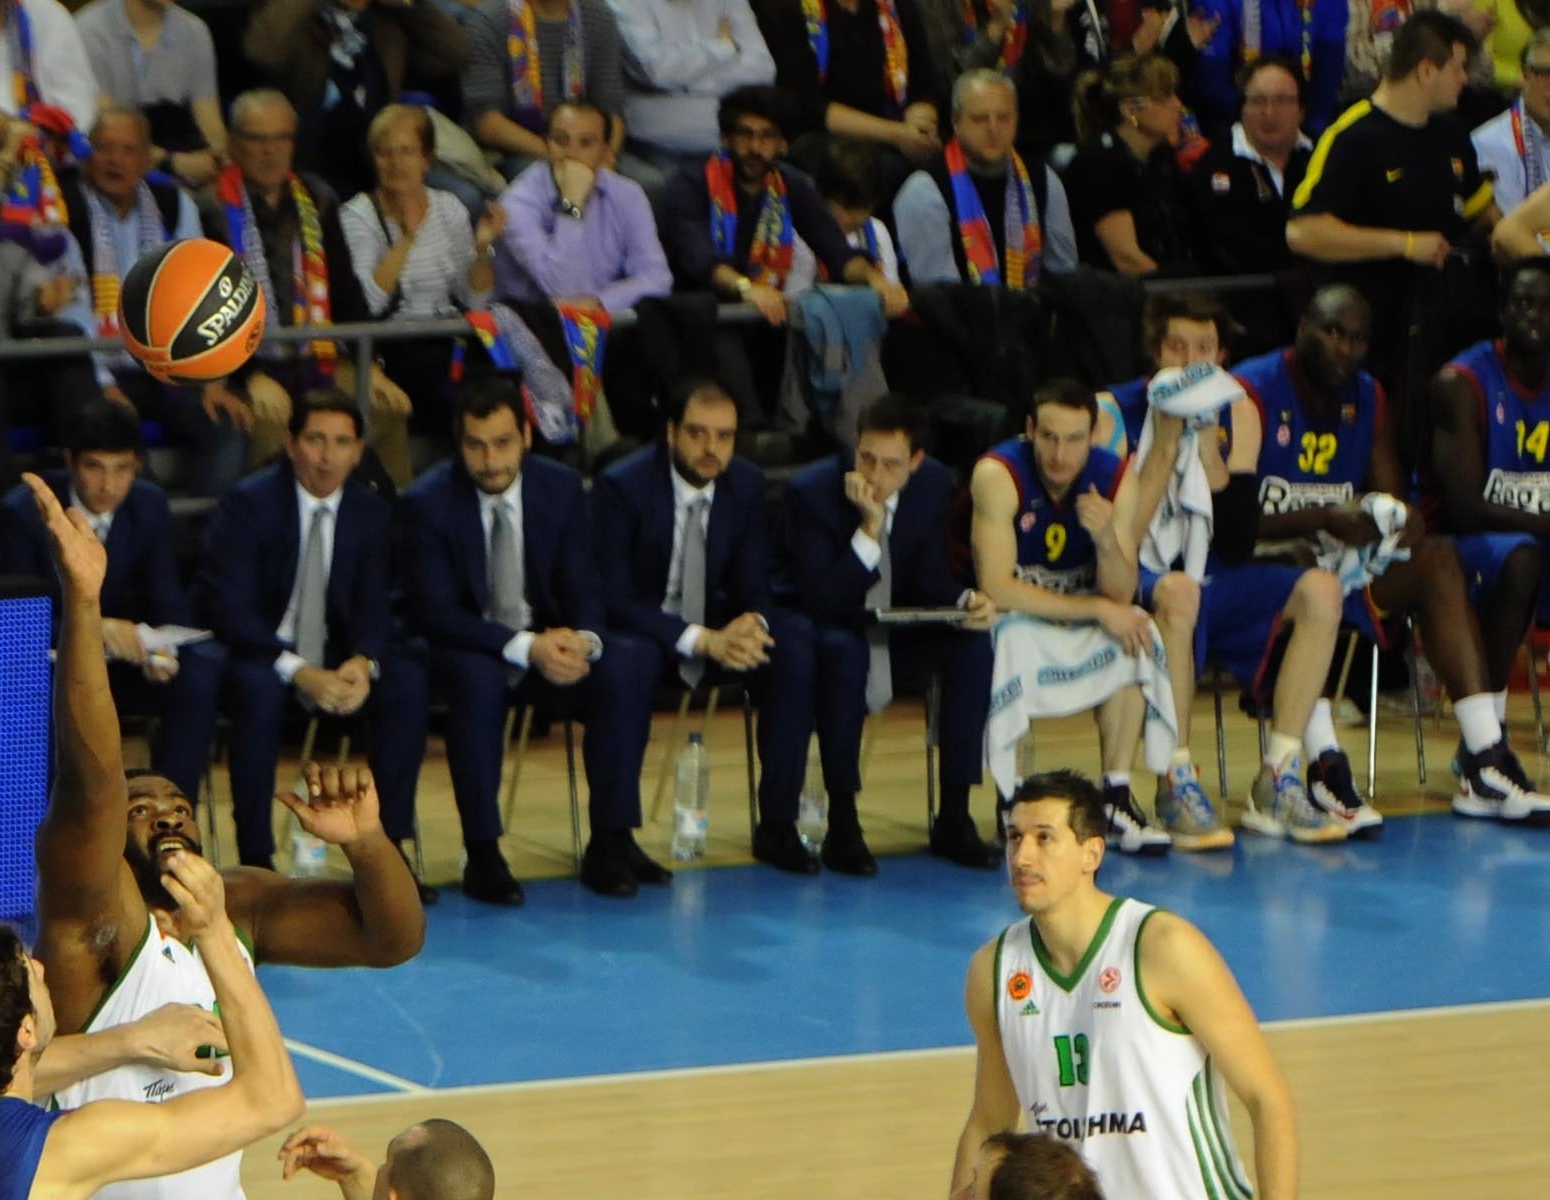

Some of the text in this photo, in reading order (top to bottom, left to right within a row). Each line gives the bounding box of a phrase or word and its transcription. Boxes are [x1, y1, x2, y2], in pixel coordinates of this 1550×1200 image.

[1298, 431, 1338, 475] 32
[1515, 419, 1550, 464] 14
[1044, 522, 1067, 562] 9
